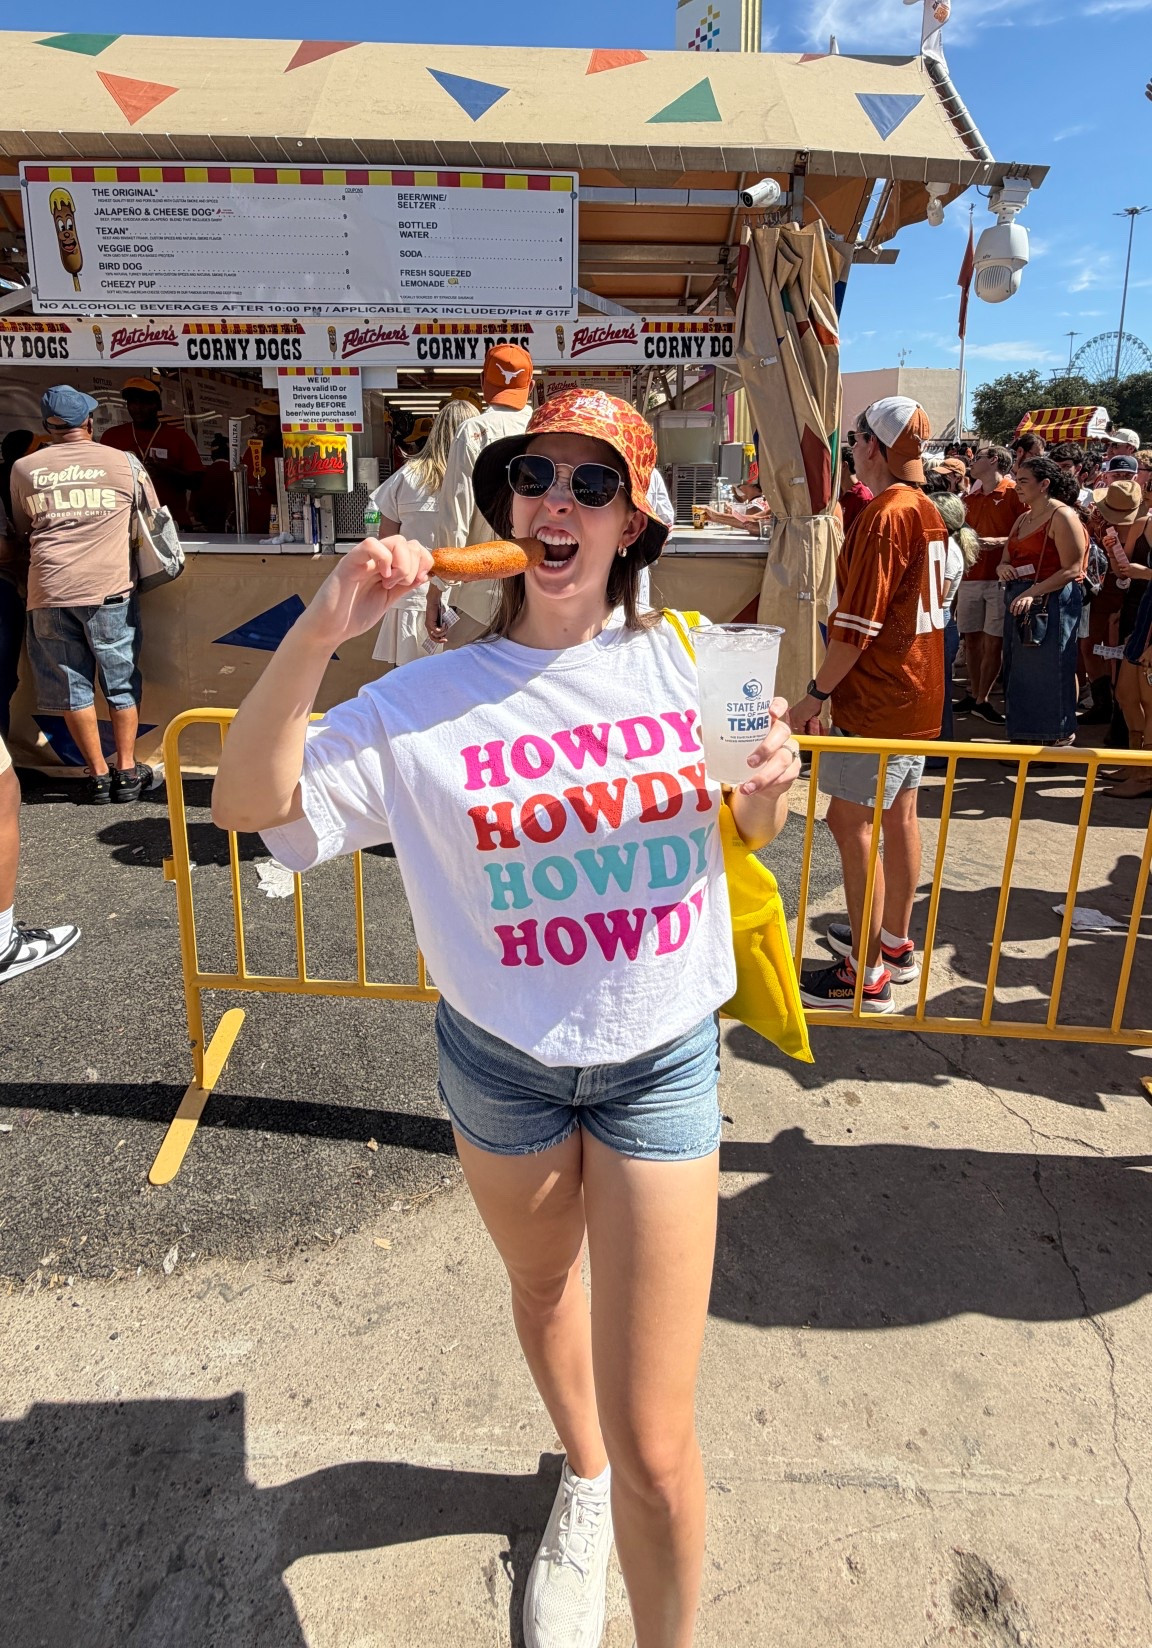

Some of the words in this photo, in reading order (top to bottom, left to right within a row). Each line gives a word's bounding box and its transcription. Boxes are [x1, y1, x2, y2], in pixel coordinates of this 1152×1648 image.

[94, 207, 141, 216] JALAPEÑO
[442, 307, 532, 316] INCLUDED/Plat
[20, 336, 69, 359] DOGS
[110, 325, 178, 352] Fletcher's
[342, 325, 410, 352] Fletcher's
[571, 323, 638, 351] Fletcher's
[644, 336, 705, 358] CORNY
[187, 338, 249, 360] CORNY
[255, 338, 302, 360] DOGS
[417, 337, 478, 360] CORNY
[321, 410, 356, 418] purchase!
[30, 465, 106, 489] Together
[53, 489, 115, 509] LOVE
[727, 703, 754, 712] STATE
[757, 700, 770, 711] FAIR
[728, 715, 769, 731] TEXAS
[460, 708, 701, 790] HOWDY
[466, 762, 713, 851] HOWDY
[484, 822, 715, 910] HOWDY
[829, 988, 854, 997] HOKA
